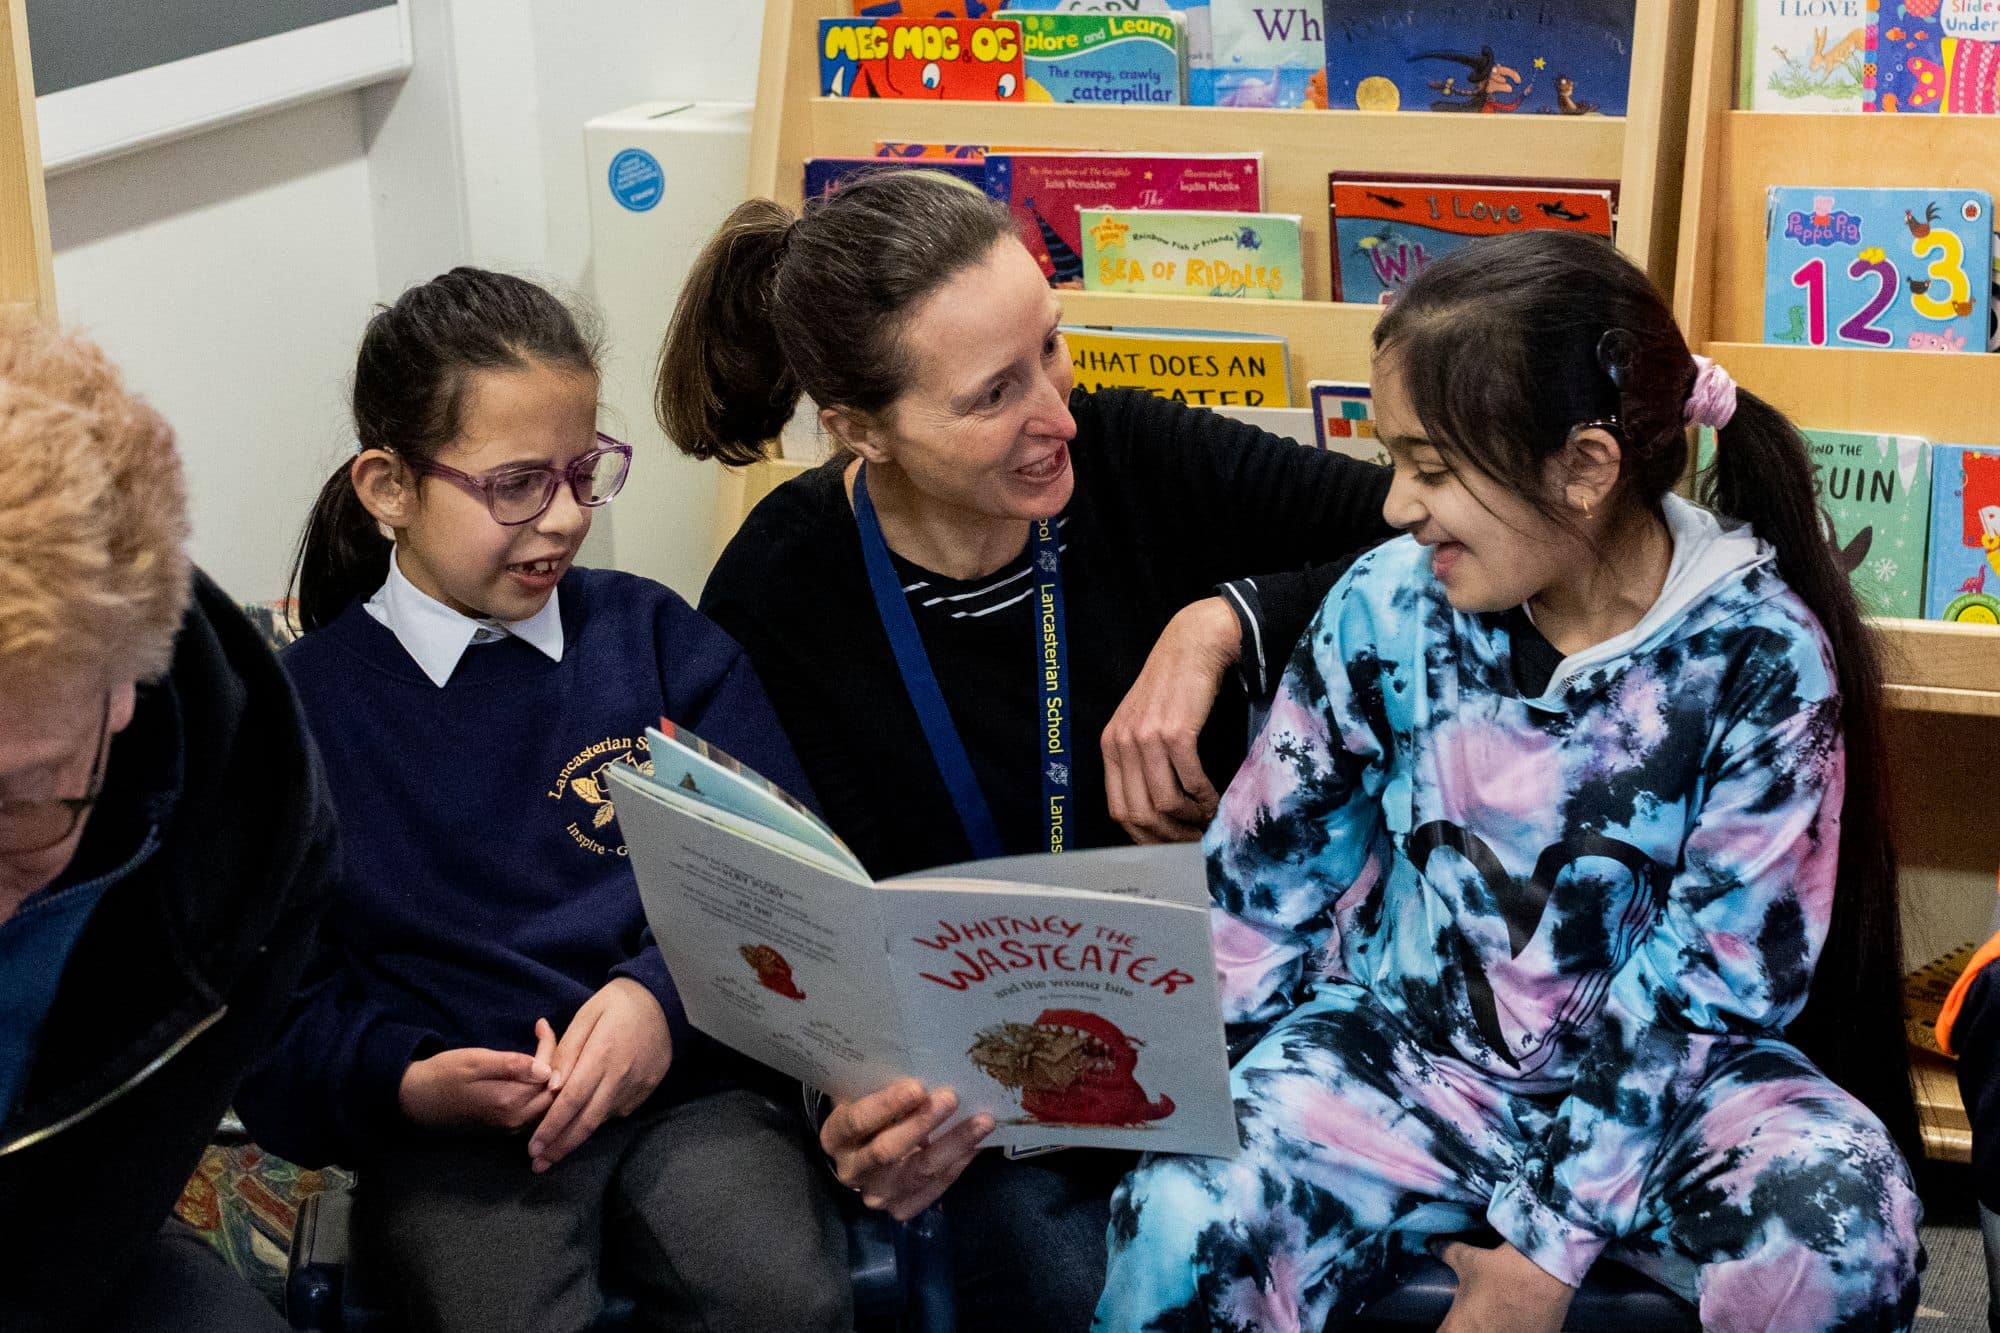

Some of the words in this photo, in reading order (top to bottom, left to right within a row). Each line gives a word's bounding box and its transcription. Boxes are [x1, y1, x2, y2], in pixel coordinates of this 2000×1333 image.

[1795, 0, 1859, 16] LOVE
[1951, 0, 1993, 13] Slide
[1083, 28, 1106, 45] and
[1108, 16, 1174, 40] Learn
[1253, 9, 1322, 41] Wh
[1946, 16, 1999, 32] Under
[825, 25, 889, 61] MEG
[892, 25, 961, 61] MOG
[971, 26, 1018, 63] OG
[1047, 65, 1071, 79] The
[1073, 68, 1116, 83] creepy,
[1119, 68, 1162, 85] crawly
[1072, 83, 1173, 105] caterpillar
[1428, 196, 1441, 220] I
[1453, 196, 1523, 223] Love
[1789, 212, 1834, 245] Peppa
[1836, 213, 1858, 241] Pig
[1100, 256, 1145, 286] SEA
[1152, 261, 1177, 281] OF
[1186, 259, 1284, 291] RIDDLES
[1073, 349, 1141, 374] WHAT
[1150, 353, 1220, 377] DOES
[1229, 355, 1266, 378] AN
[1839, 444, 1863, 457] THE
[1041, 583, 1061, 692] Lancasterian
[1046, 697, 1065, 754] School
[547, 737, 632, 800] Lancasterian
[566, 822, 605, 855] Inspire
[1050, 795, 1066, 853] Lancas
[913, 915, 1083, 952] WHITNEY
[1097, 926, 1139, 948] THE
[919, 940, 1195, 995] WASTEATER
[1104, 981, 1134, 997] bite
